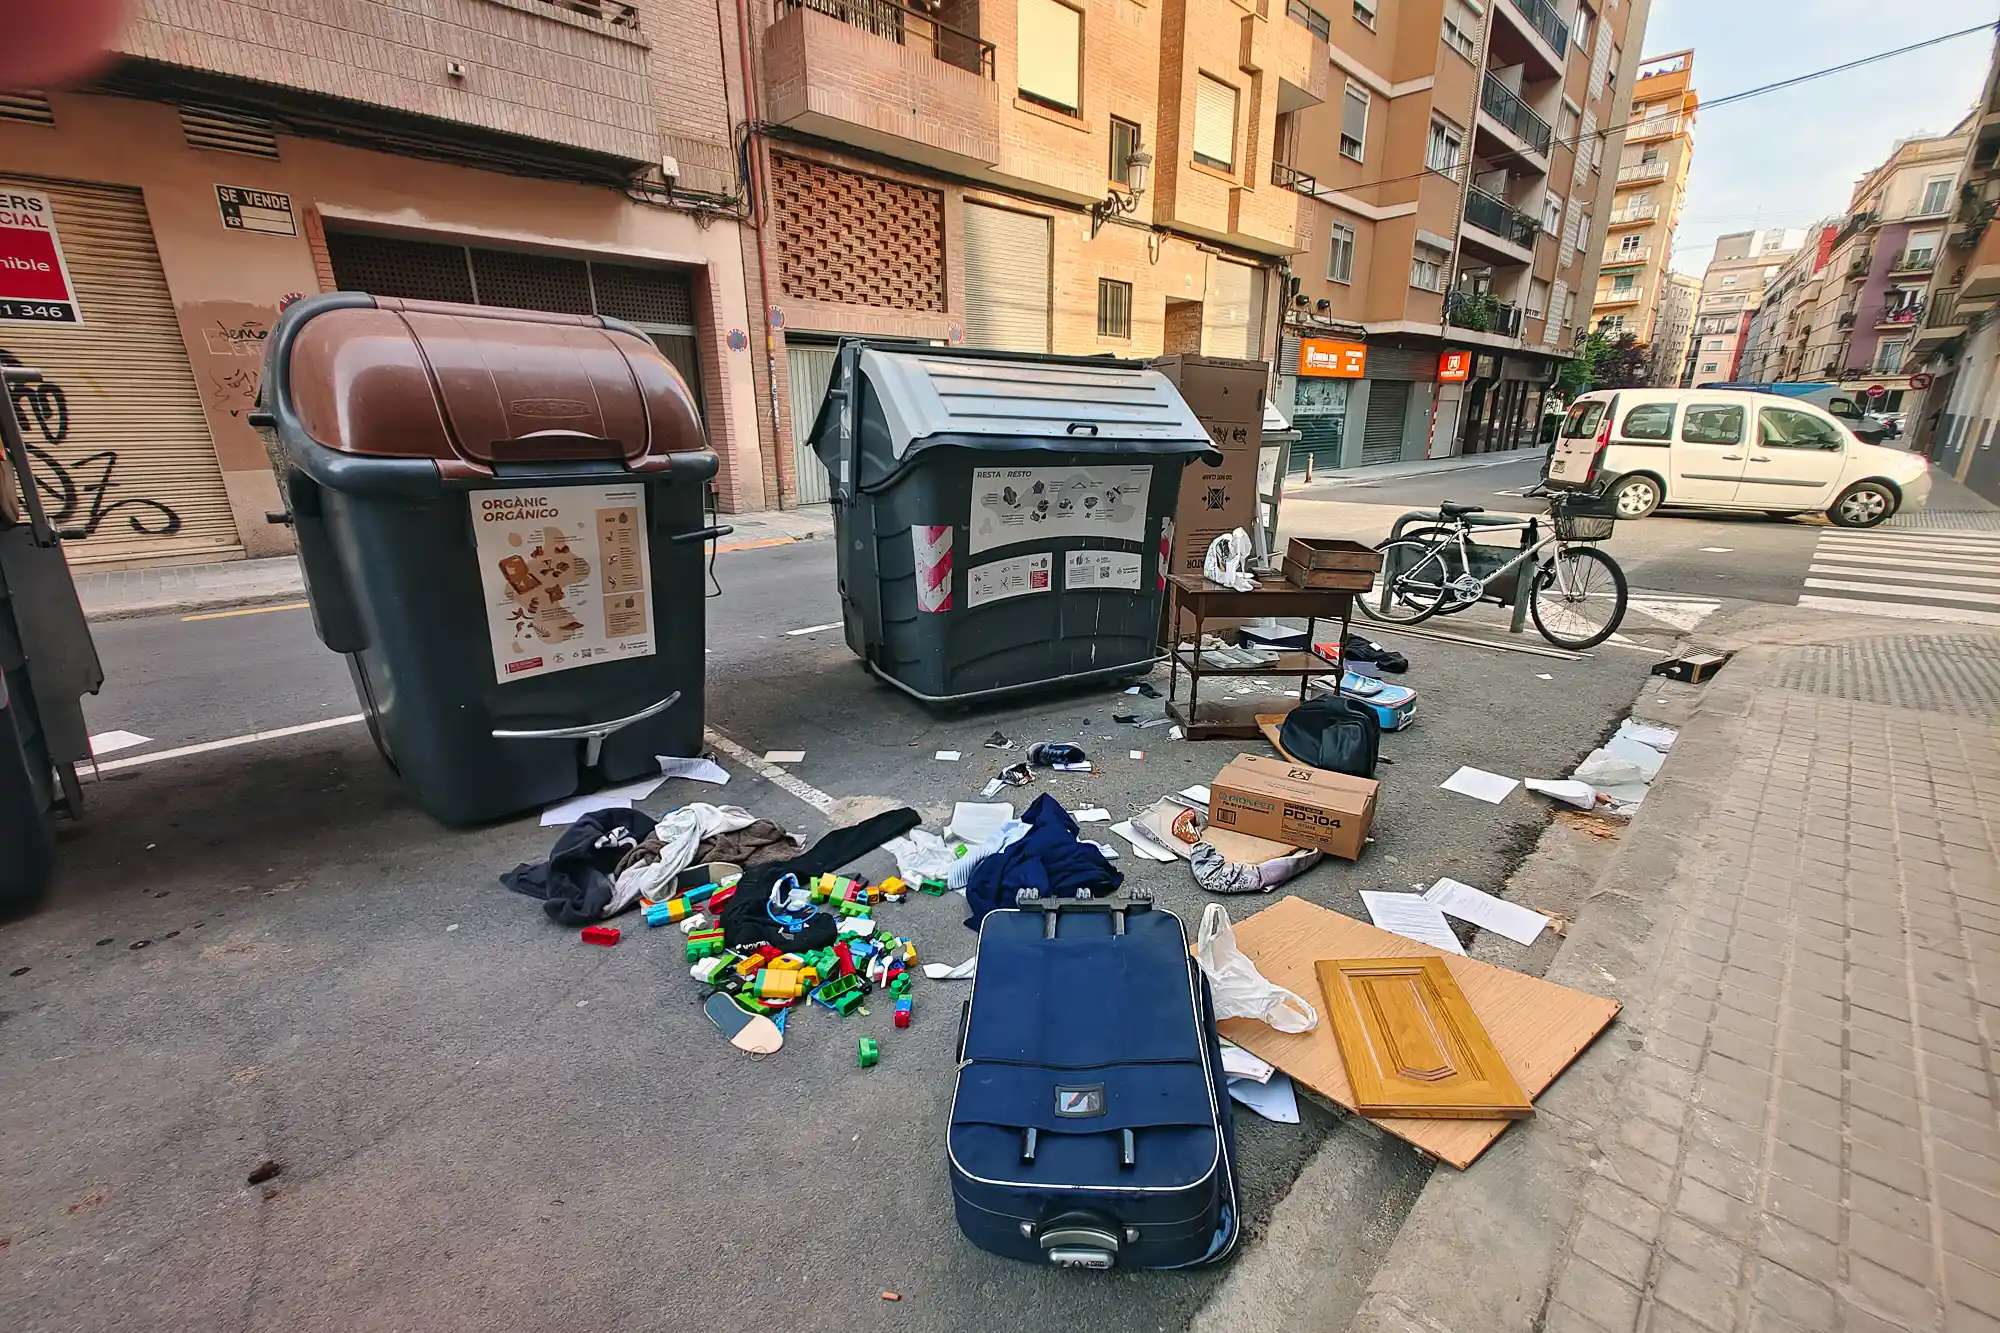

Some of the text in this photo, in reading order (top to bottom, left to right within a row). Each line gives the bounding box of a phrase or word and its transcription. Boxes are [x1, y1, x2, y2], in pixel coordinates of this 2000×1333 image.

[219, 187, 290, 210] SE VENDE
[0, 211, 49, 229] CIAL
[20, 304, 63, 318] 346
[977, 470, 1032, 479] RESTA RESTO
[482, 496, 549, 510] ORGÀNIC
[483, 508, 559, 522] ORGÁNICO
[1283, 808, 1341, 829] PD-104
